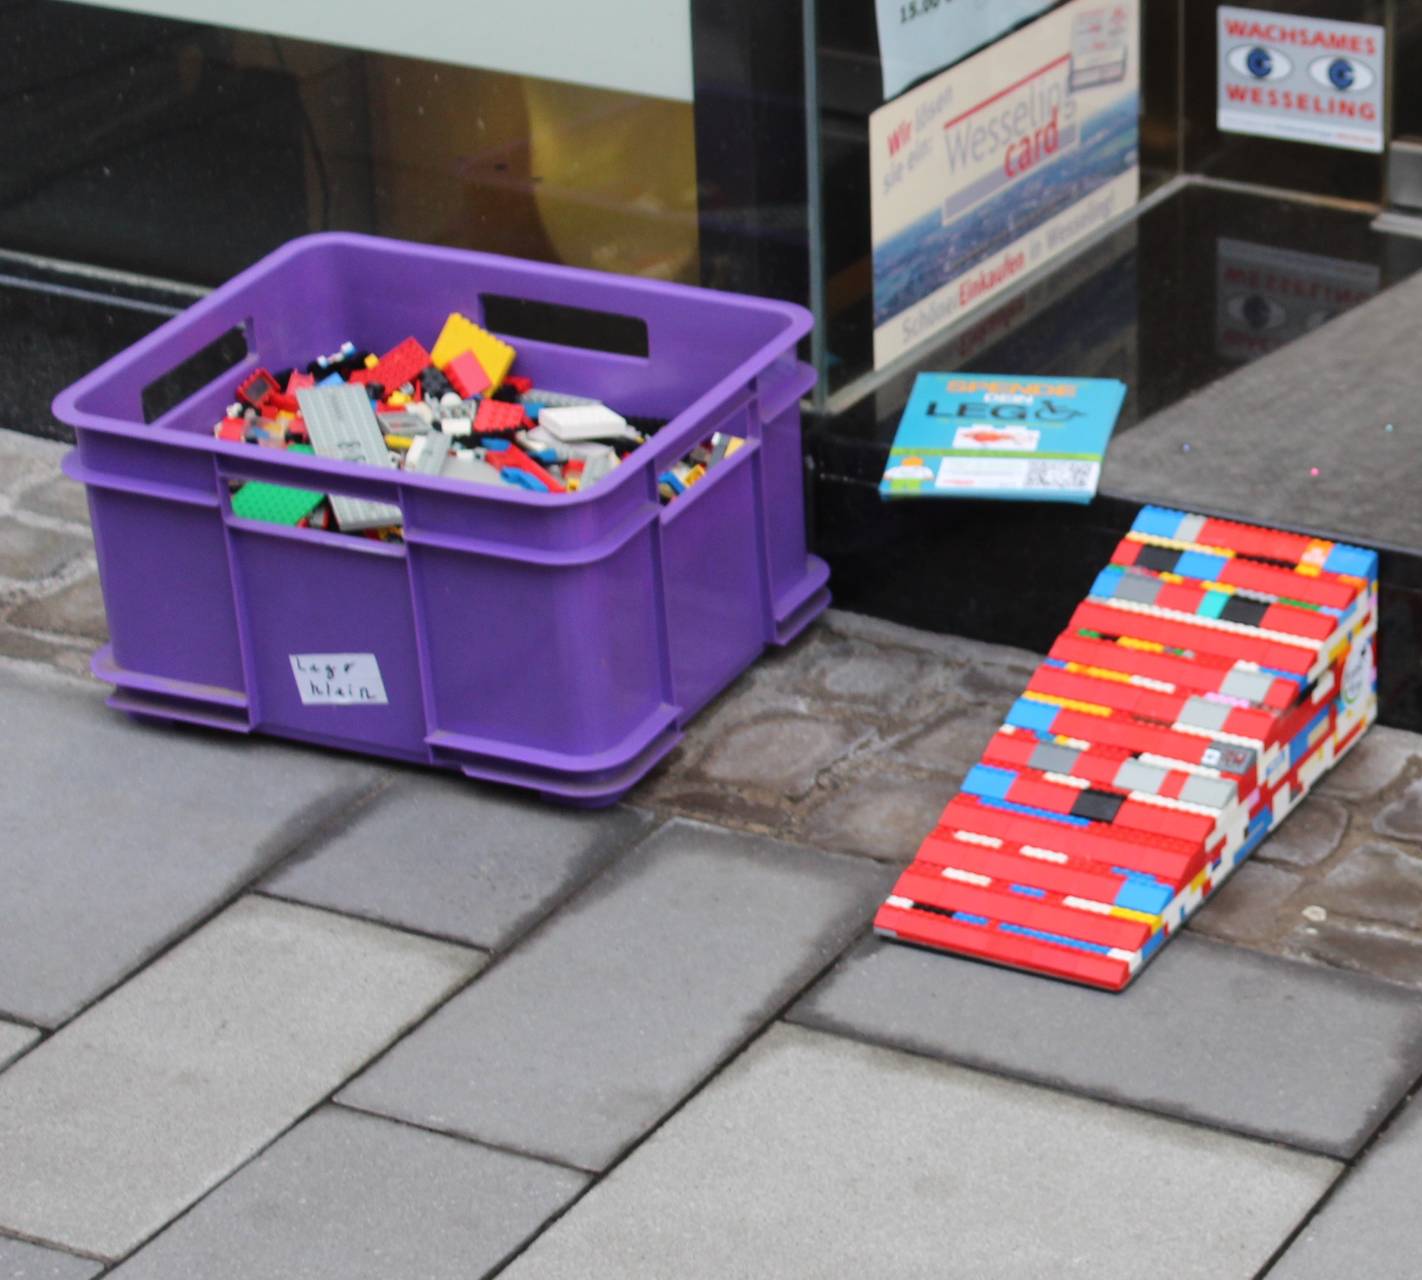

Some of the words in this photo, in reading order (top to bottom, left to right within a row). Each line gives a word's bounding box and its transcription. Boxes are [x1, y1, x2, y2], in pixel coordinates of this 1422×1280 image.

[1224, 18, 1376, 56] WACHSAMES
[1226, 83, 1377, 122] WESSELING
[887, 119, 911, 158] Wir
[1004, 106, 1058, 177] card
[960, 250, 1025, 307] Einkaufen
[946, 380, 1077, 398] SPENDE
